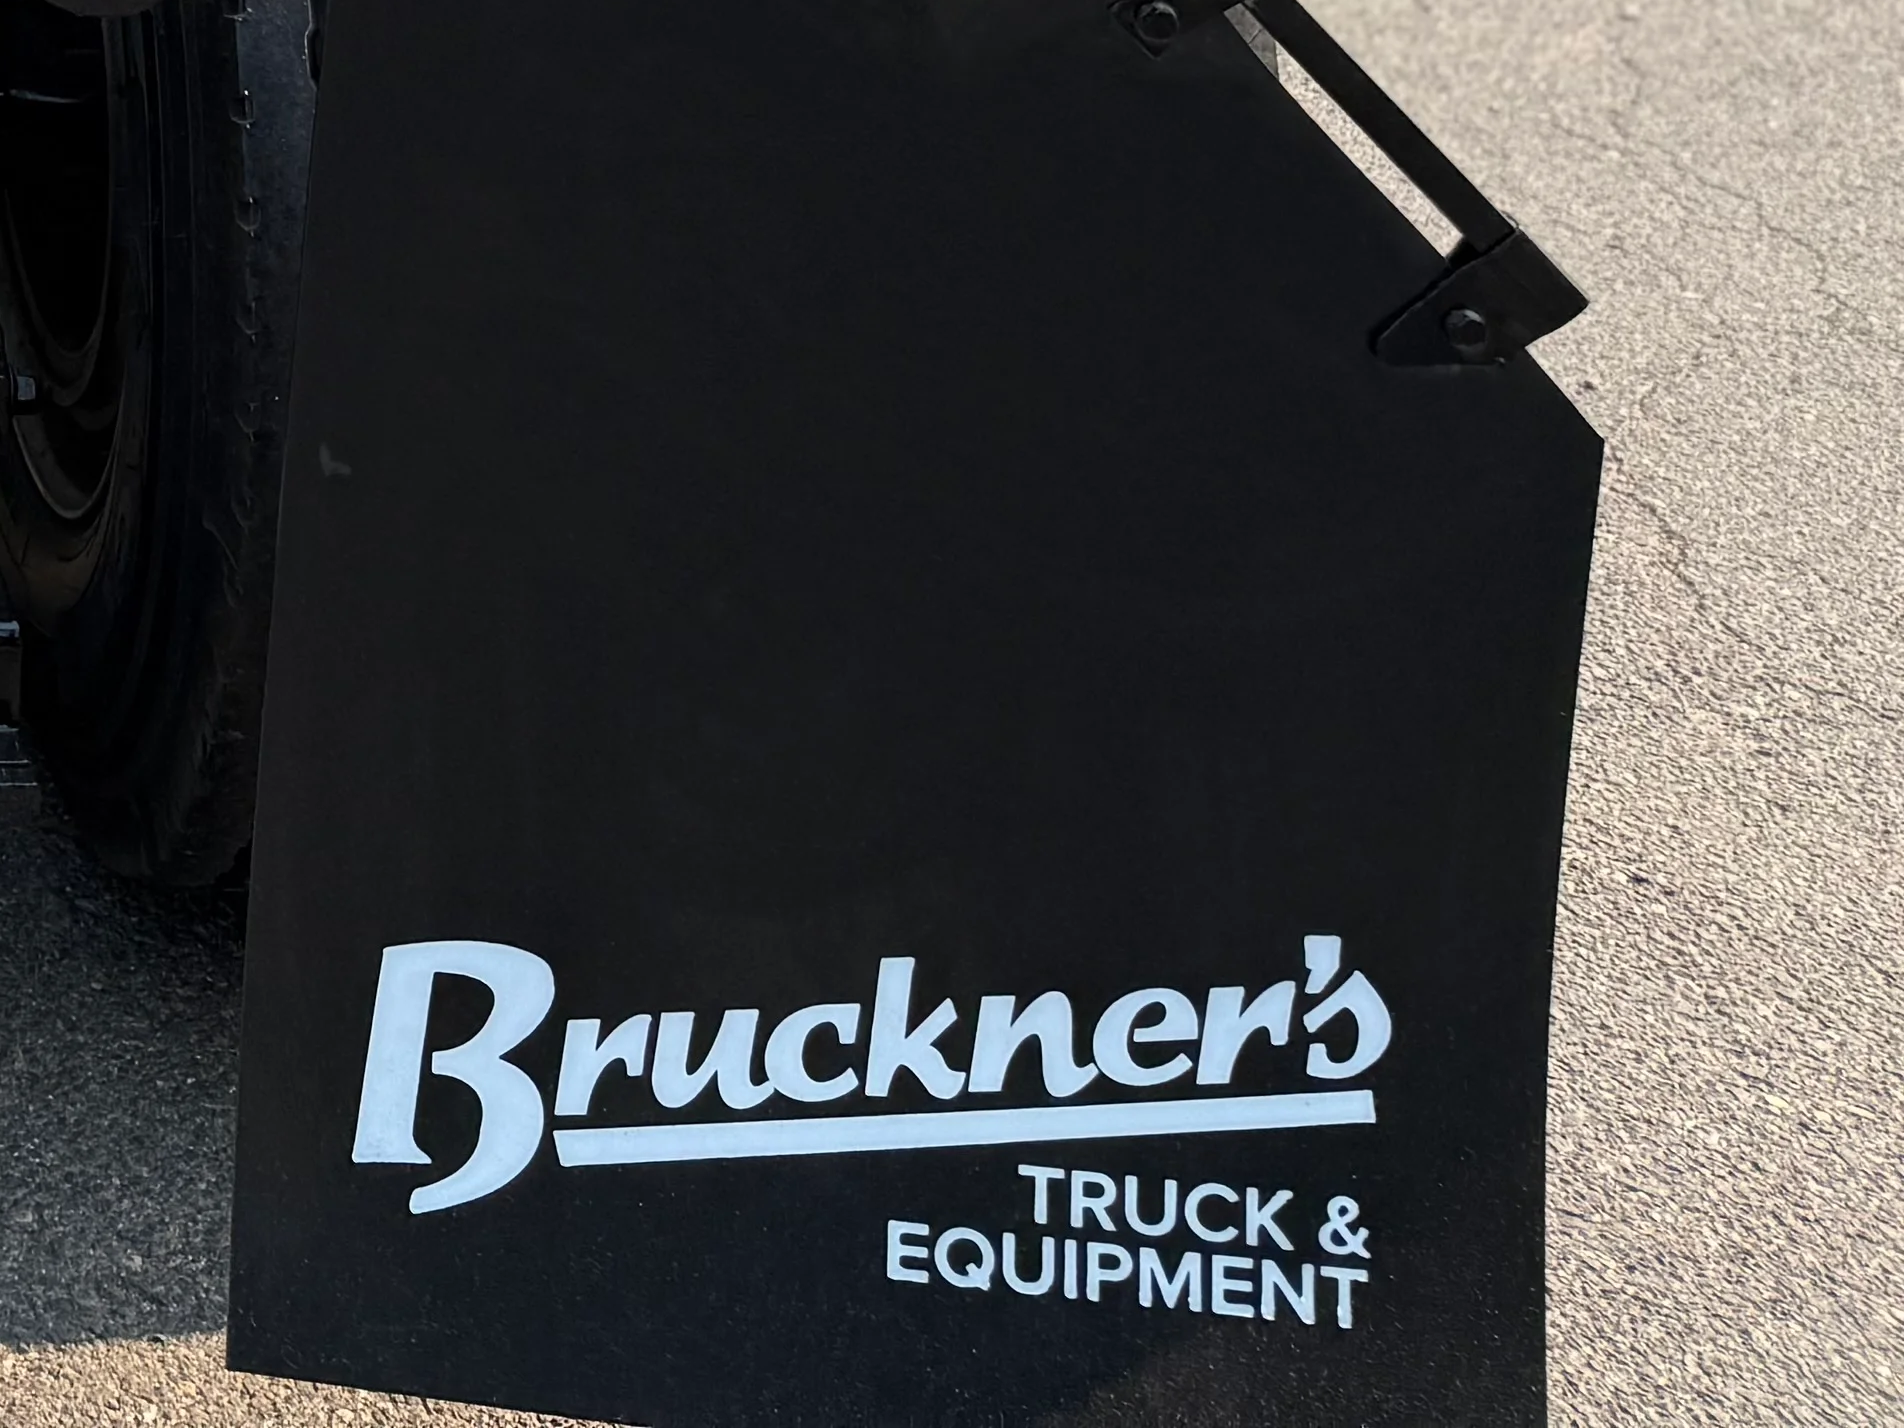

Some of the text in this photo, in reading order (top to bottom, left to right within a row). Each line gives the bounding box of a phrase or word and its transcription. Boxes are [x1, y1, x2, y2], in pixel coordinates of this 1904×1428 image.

[351, 934, 1392, 1215] Bruckner's
[1017, 1164, 1372, 1259] TRUCK &
[886, 1219, 1369, 1330] EQUIPMENT
